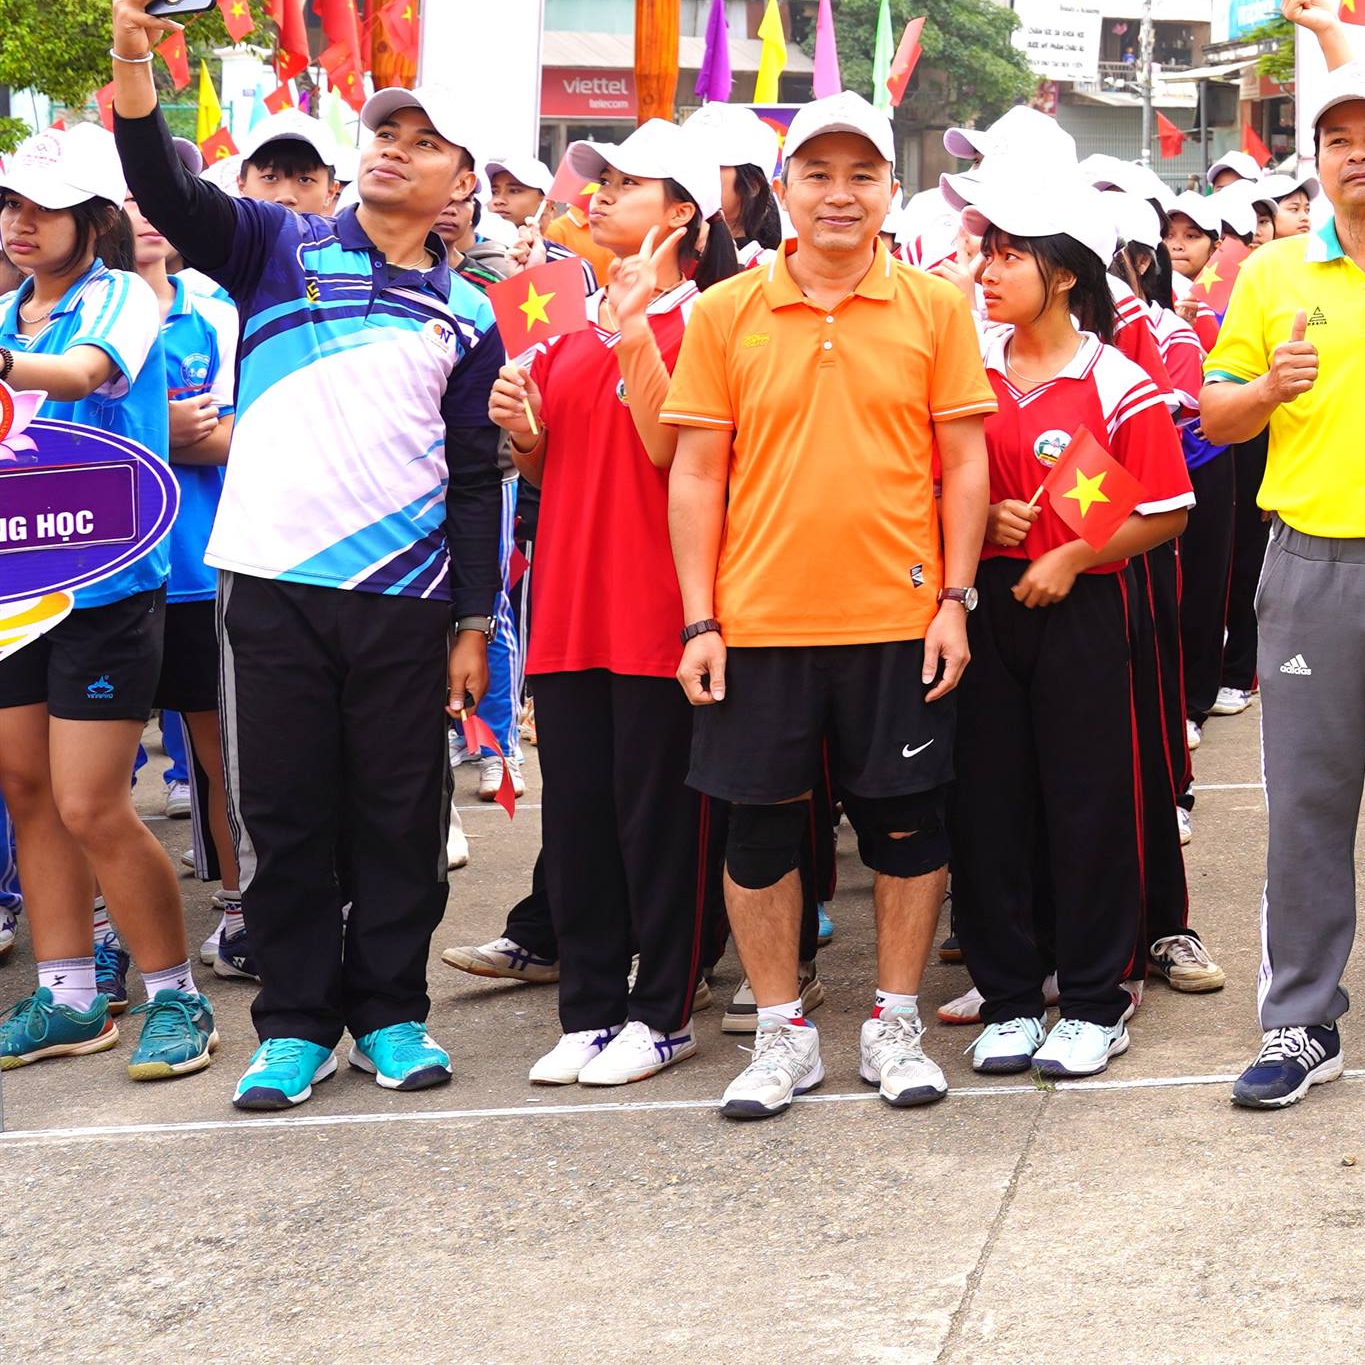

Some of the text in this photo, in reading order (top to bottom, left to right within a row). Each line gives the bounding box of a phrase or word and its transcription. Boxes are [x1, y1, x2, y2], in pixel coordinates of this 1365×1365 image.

[563, 77, 629, 95] viettel
[589, 98, 629, 108] telecom
[37, 510, 94, 542] HỌC
[1280, 665, 1312, 676] adidas
